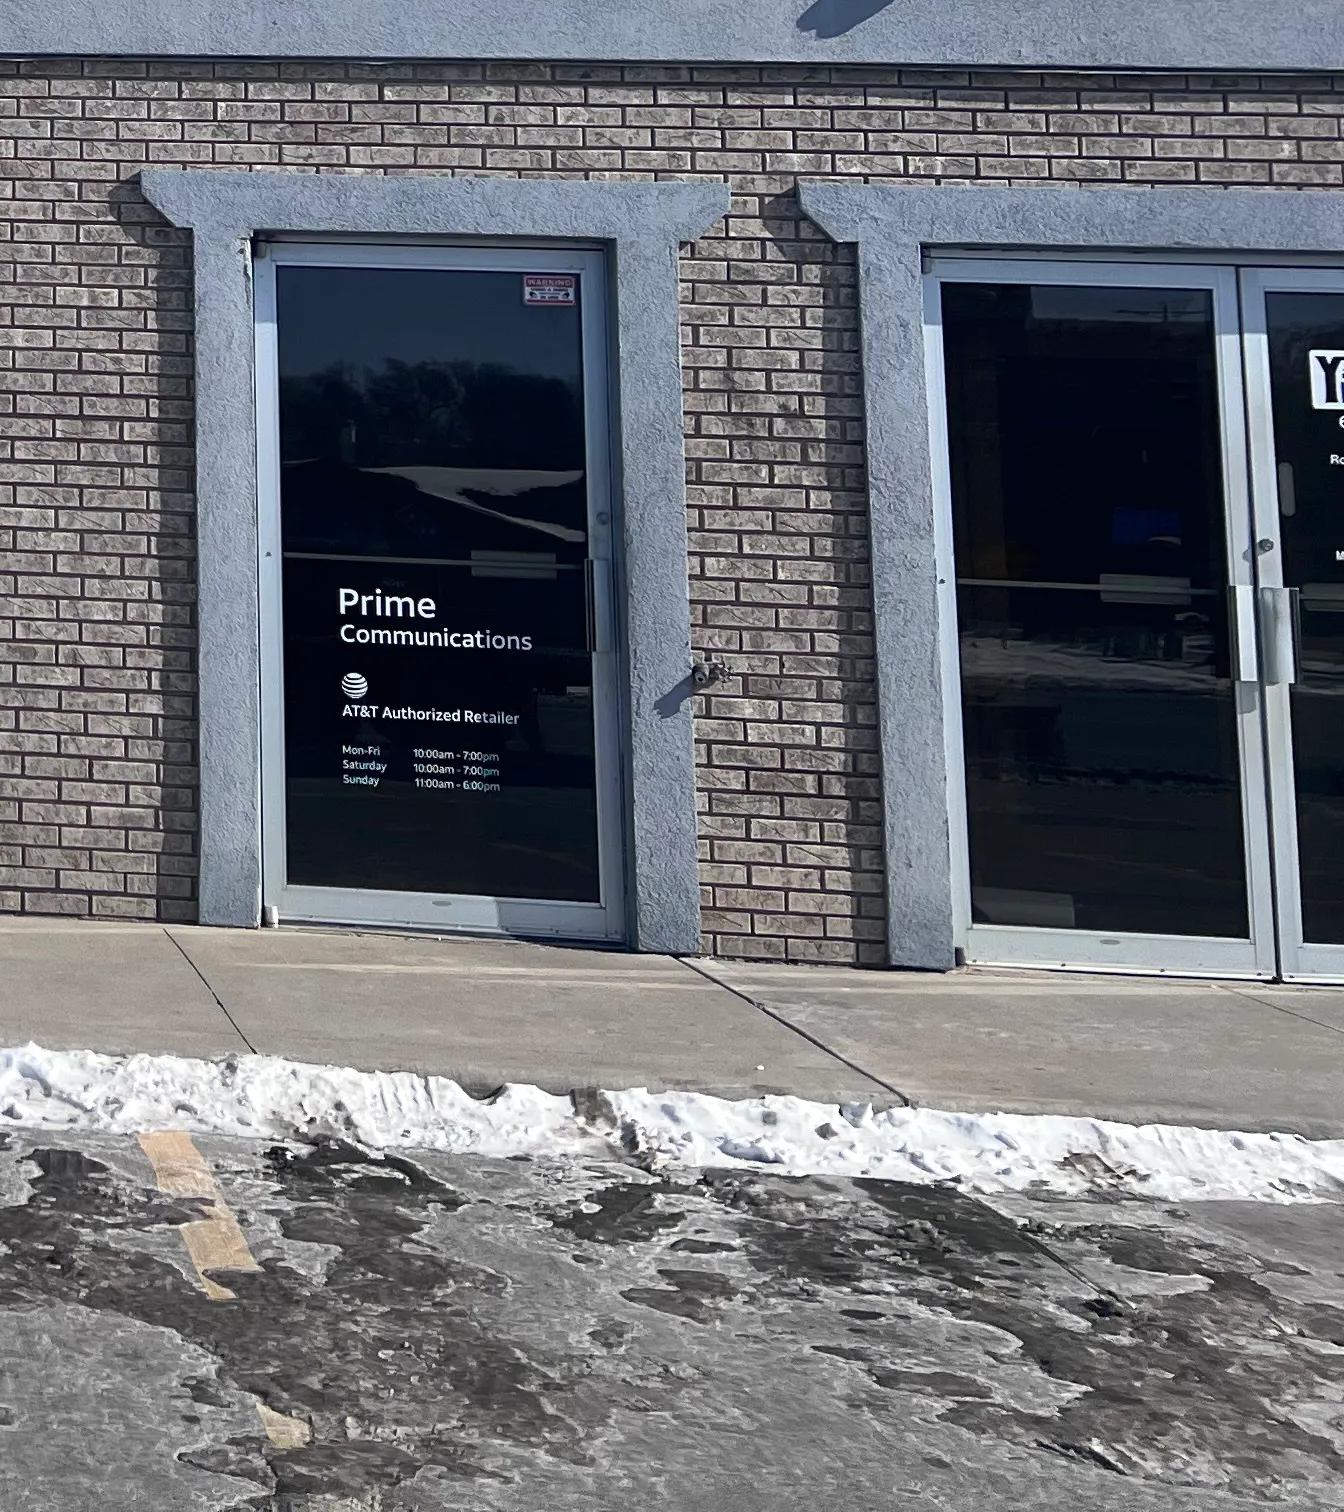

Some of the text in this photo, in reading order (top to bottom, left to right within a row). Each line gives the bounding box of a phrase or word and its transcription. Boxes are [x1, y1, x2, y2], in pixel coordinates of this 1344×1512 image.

[339, 588, 436, 618] Prime
[340, 624, 533, 651] Communications
[342, 705, 520, 725] AT&T Authorized Retailer
[342, 745, 381, 756] Mon-Fri
[413, 749, 454, 760] 10:00am
[462, 751, 499, 762] 7:00pm
[342, 760, 387, 773] Saturday
[413, 764, 454, 774] 10:00am
[463, 766, 500, 778] 7:00pm
[343, 774, 379, 787] Sunday
[415, 778, 454, 789] 11:00am
[463, 781, 500, 792] 6:00pm
